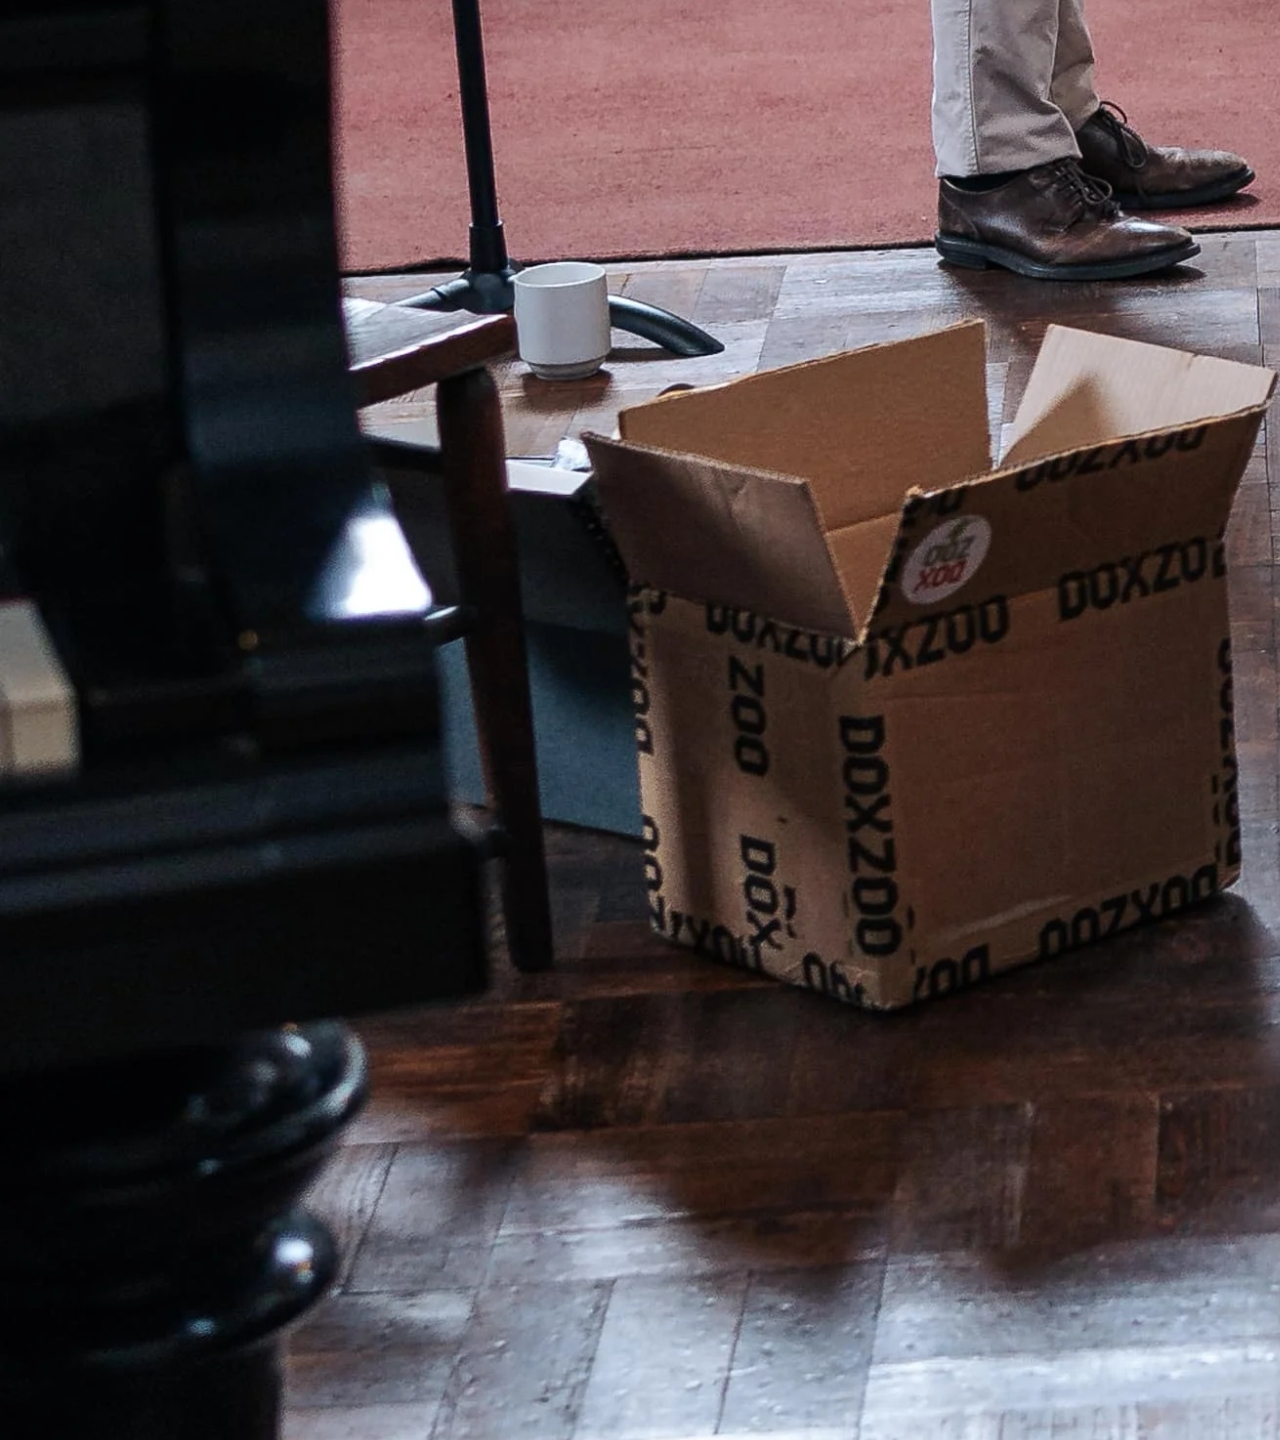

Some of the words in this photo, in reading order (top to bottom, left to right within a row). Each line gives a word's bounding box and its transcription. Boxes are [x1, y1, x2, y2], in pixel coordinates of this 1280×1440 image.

[728, 655, 771, 777] ZOO
[740, 835, 784, 950] DOX
[839, 715, 904, 957] DOXZOO
